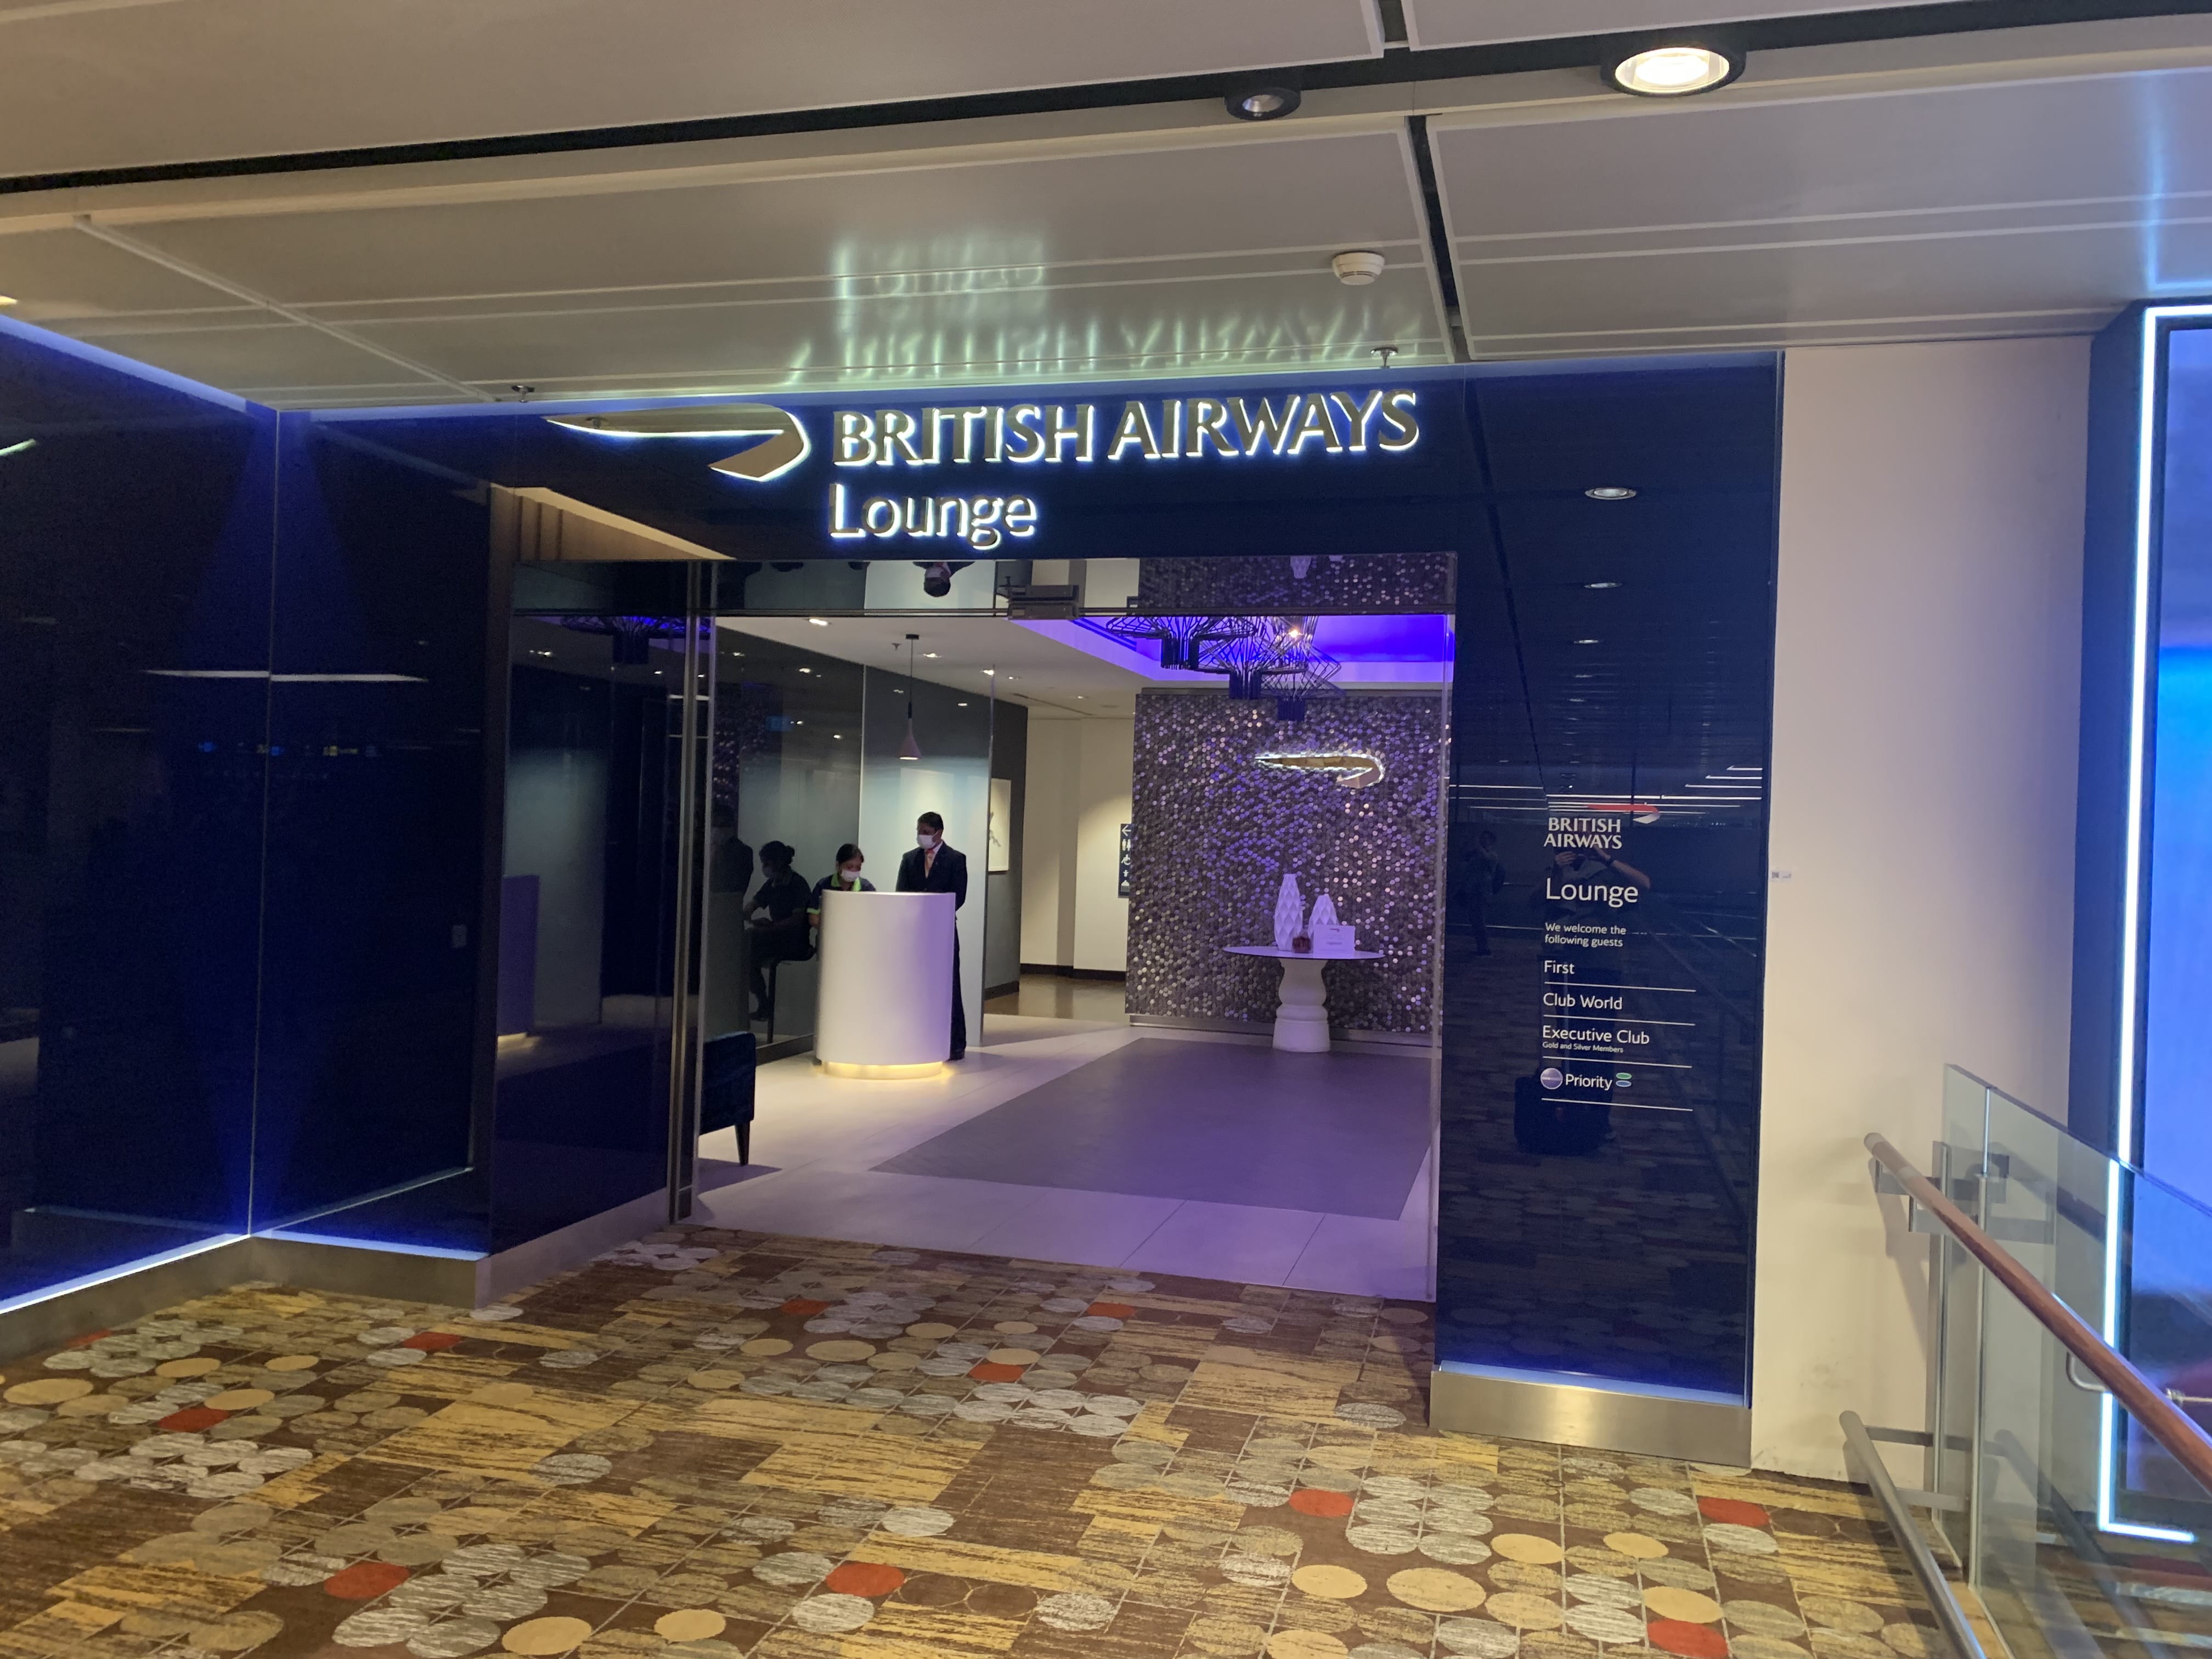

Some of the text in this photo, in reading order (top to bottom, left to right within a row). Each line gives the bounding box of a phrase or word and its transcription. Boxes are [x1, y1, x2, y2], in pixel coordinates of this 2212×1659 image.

[833, 391, 1420, 467] BRITISH AIRWAYS
[830, 483, 1037, 550] Lounge
[1548, 817, 1621, 833] BRITISH
[1543, 833, 1622, 849] AIRWAYS
[1546, 877, 1639, 908] Lounge
[1545, 922, 1627, 935] We welcome the
[1544, 935, 1623, 947] following guests
[1544, 960, 1575, 974] First
[1543, 992, 1623, 1010] Club World
[1542, 1025, 1650, 1045] Executive Club
[1593, 1045, 1624, 1053] Members
[1565, 1074, 1613, 1091] Priority
